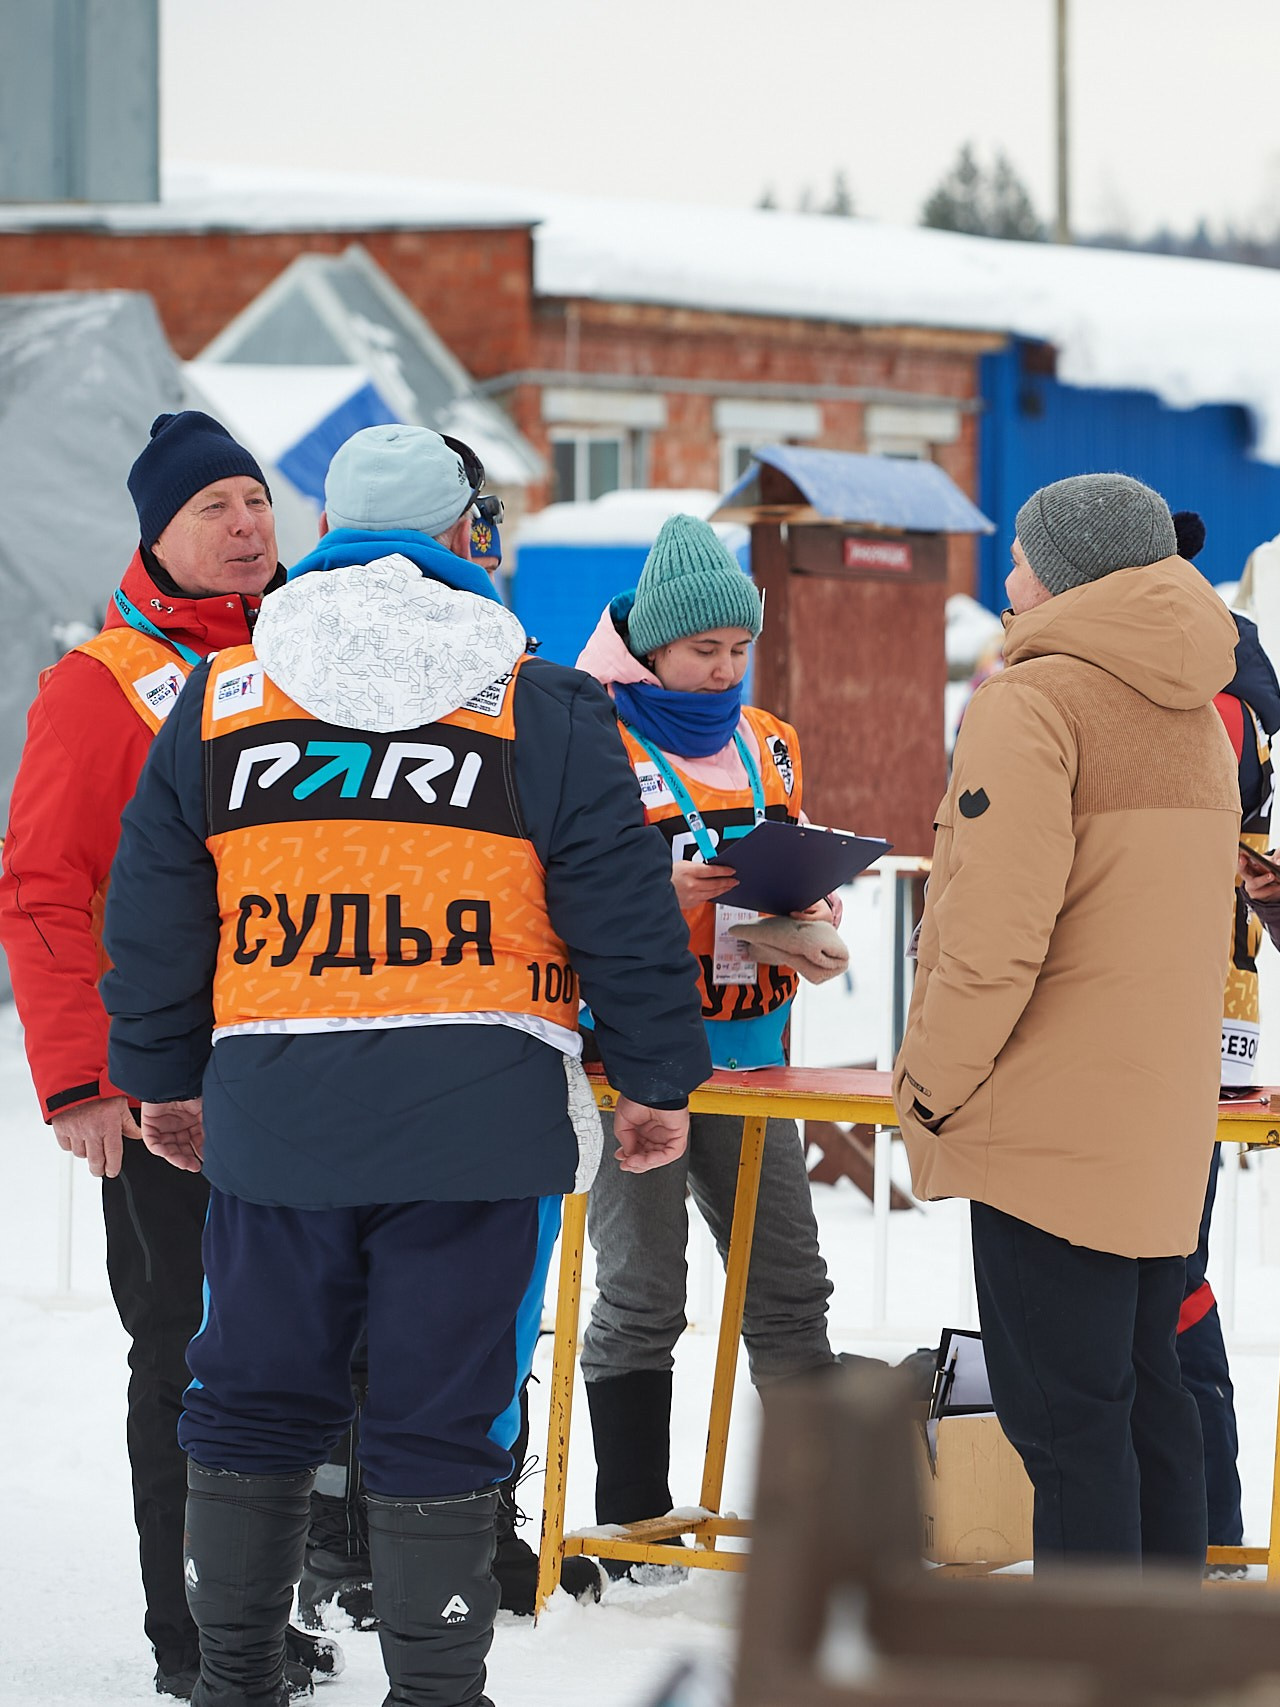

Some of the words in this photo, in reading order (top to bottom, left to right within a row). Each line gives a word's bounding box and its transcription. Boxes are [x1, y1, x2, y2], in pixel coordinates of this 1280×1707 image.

[228, 741, 483, 811] PARI
[233, 893, 496, 977] СУДЬЯ
[526, 960, 574, 1005] 100
[446, 1615, 466, 1624] ALFA
